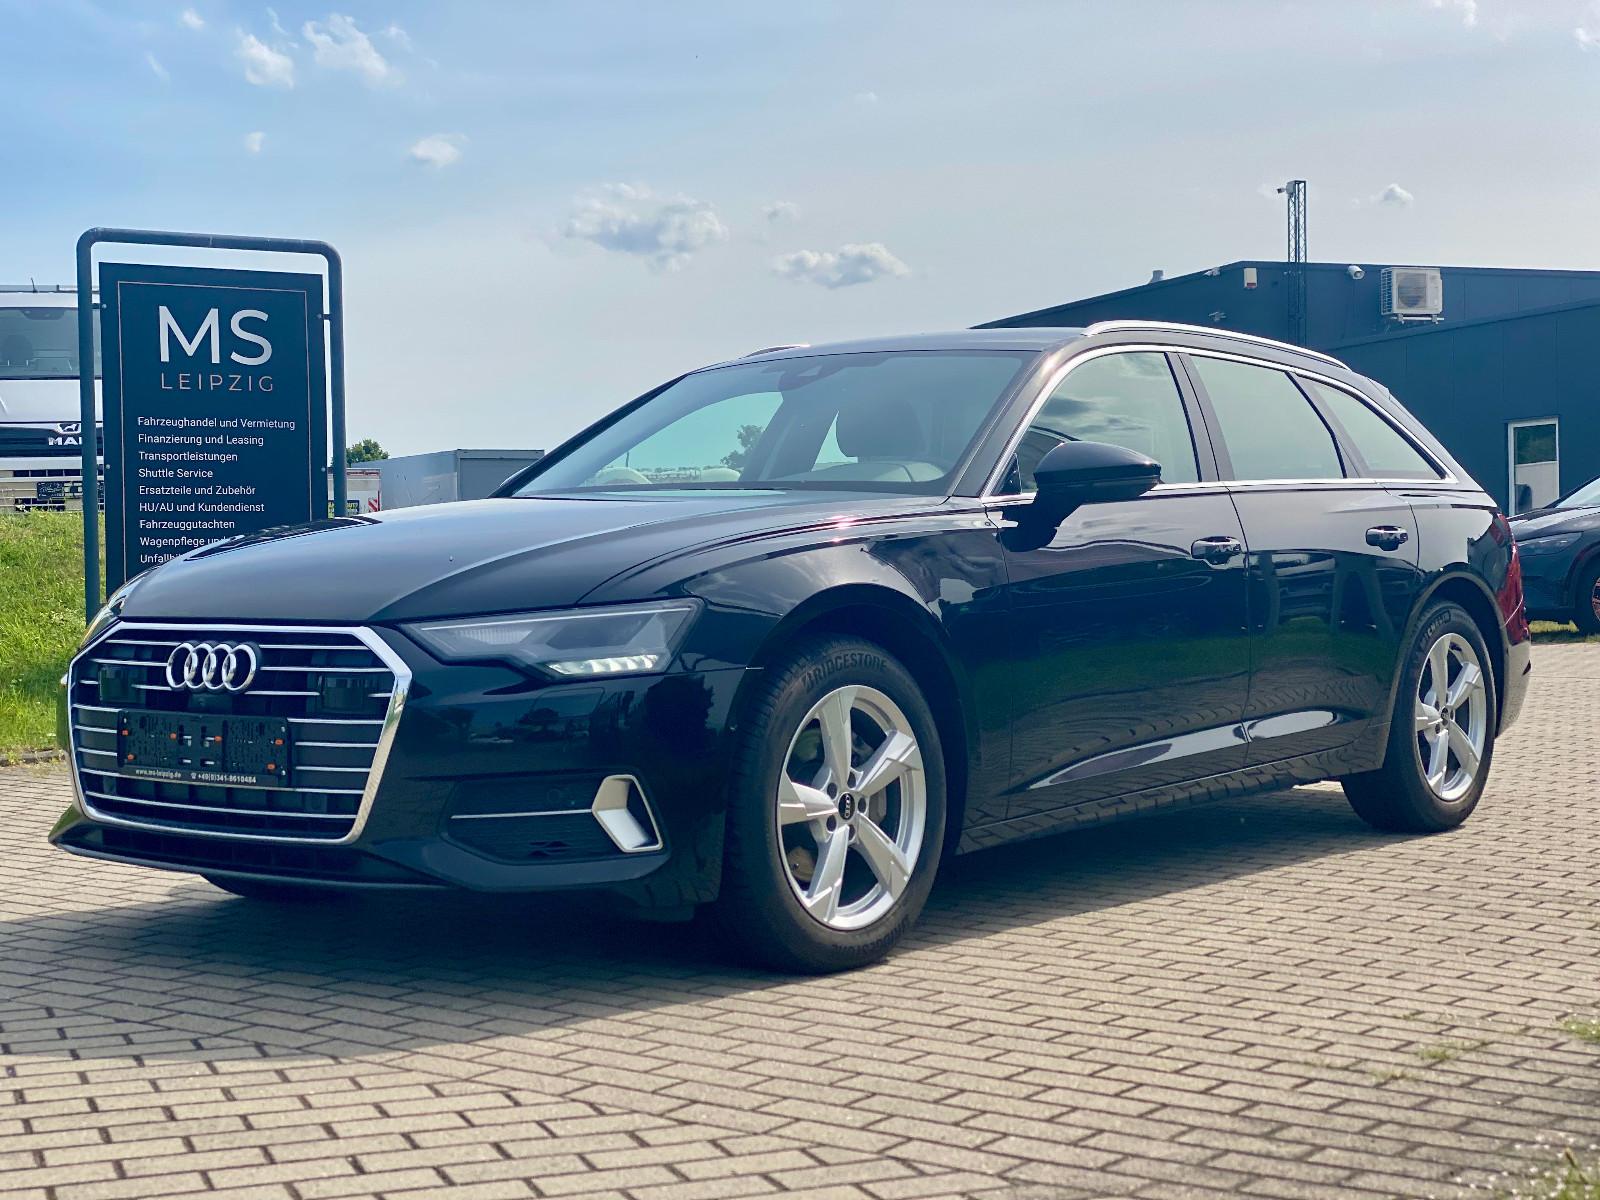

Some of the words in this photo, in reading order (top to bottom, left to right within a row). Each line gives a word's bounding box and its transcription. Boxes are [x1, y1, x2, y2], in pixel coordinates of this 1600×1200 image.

[158, 305, 273, 366] MS
[161, 372, 274, 393] LEIPZIG
[137, 416, 217, 429] Fahrzeughandel
[219, 418, 238, 428] und
[240, 418, 296, 430] Vermietung
[138, 434, 202, 446] Finanzierung
[205, 435, 223, 444] und
[226, 435, 264, 447] Leasing
[138, 451, 238, 463] Transportleistungen
[138, 468, 174, 478] Shuttle
[176, 469, 214, 478] Service
[139, 485, 192, 495] Ersatzteile
[194, 485, 213, 495] und
[215, 485, 256, 495] Zubehör
[139, 502, 174, 512] HU/AU
[176, 502, 195, 512] und
[198, 502, 265, 512] Kundendienst
[139, 519, 235, 531] Fahrzeuggutachten
[139, 536, 205, 548] Wagenpflege
